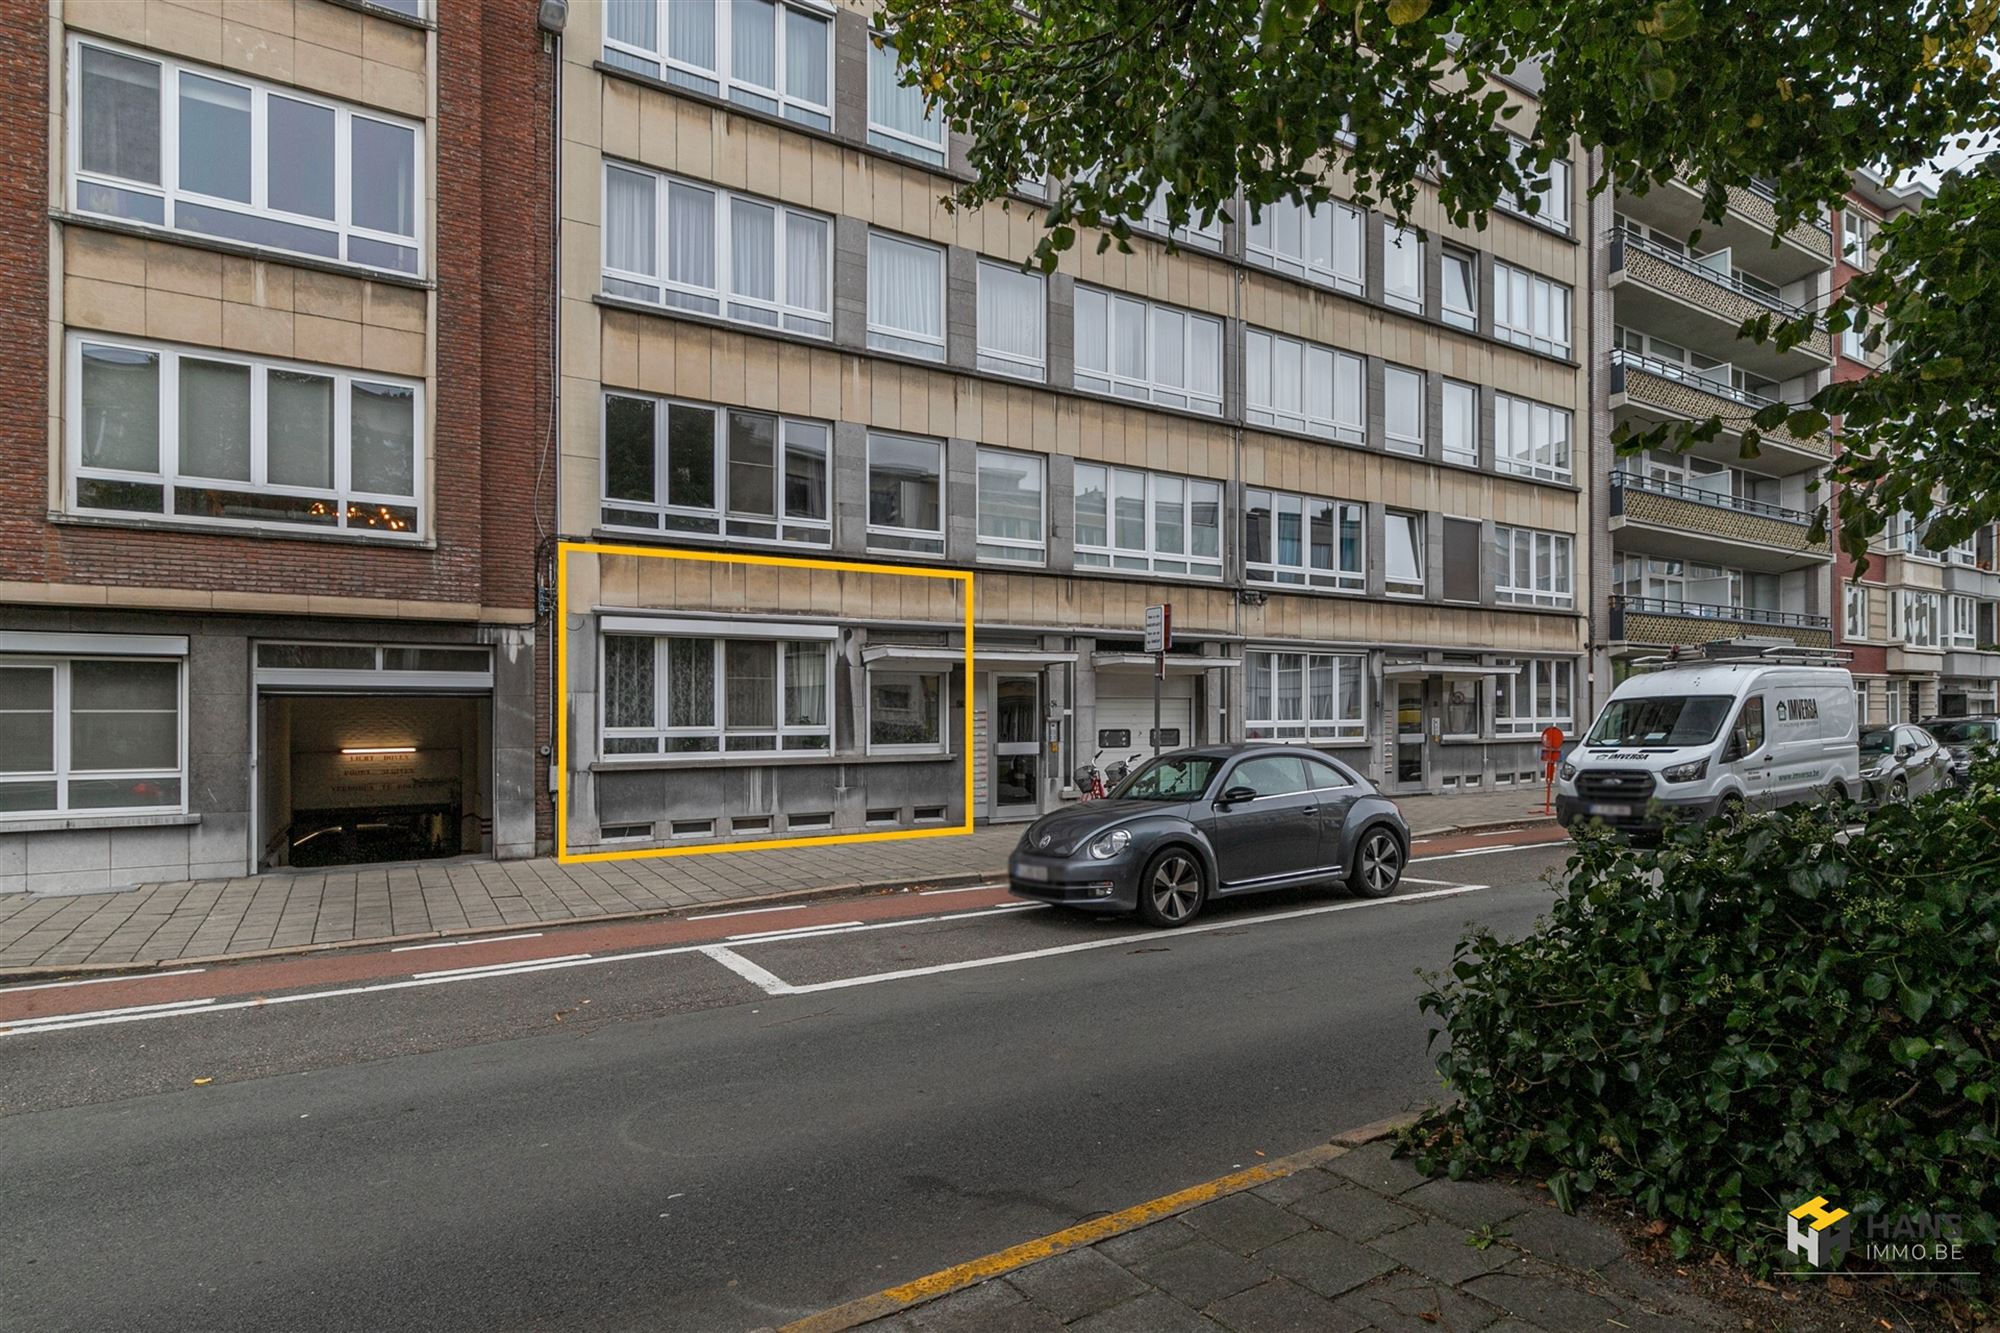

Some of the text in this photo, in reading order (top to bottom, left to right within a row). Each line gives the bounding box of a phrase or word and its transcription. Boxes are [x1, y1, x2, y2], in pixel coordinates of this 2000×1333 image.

[1788, 698, 1819, 721] IMVERSA
[1608, 753, 1650, 761] IMVERSA
[1778, 770, 1820, 782] www.imversa.be
